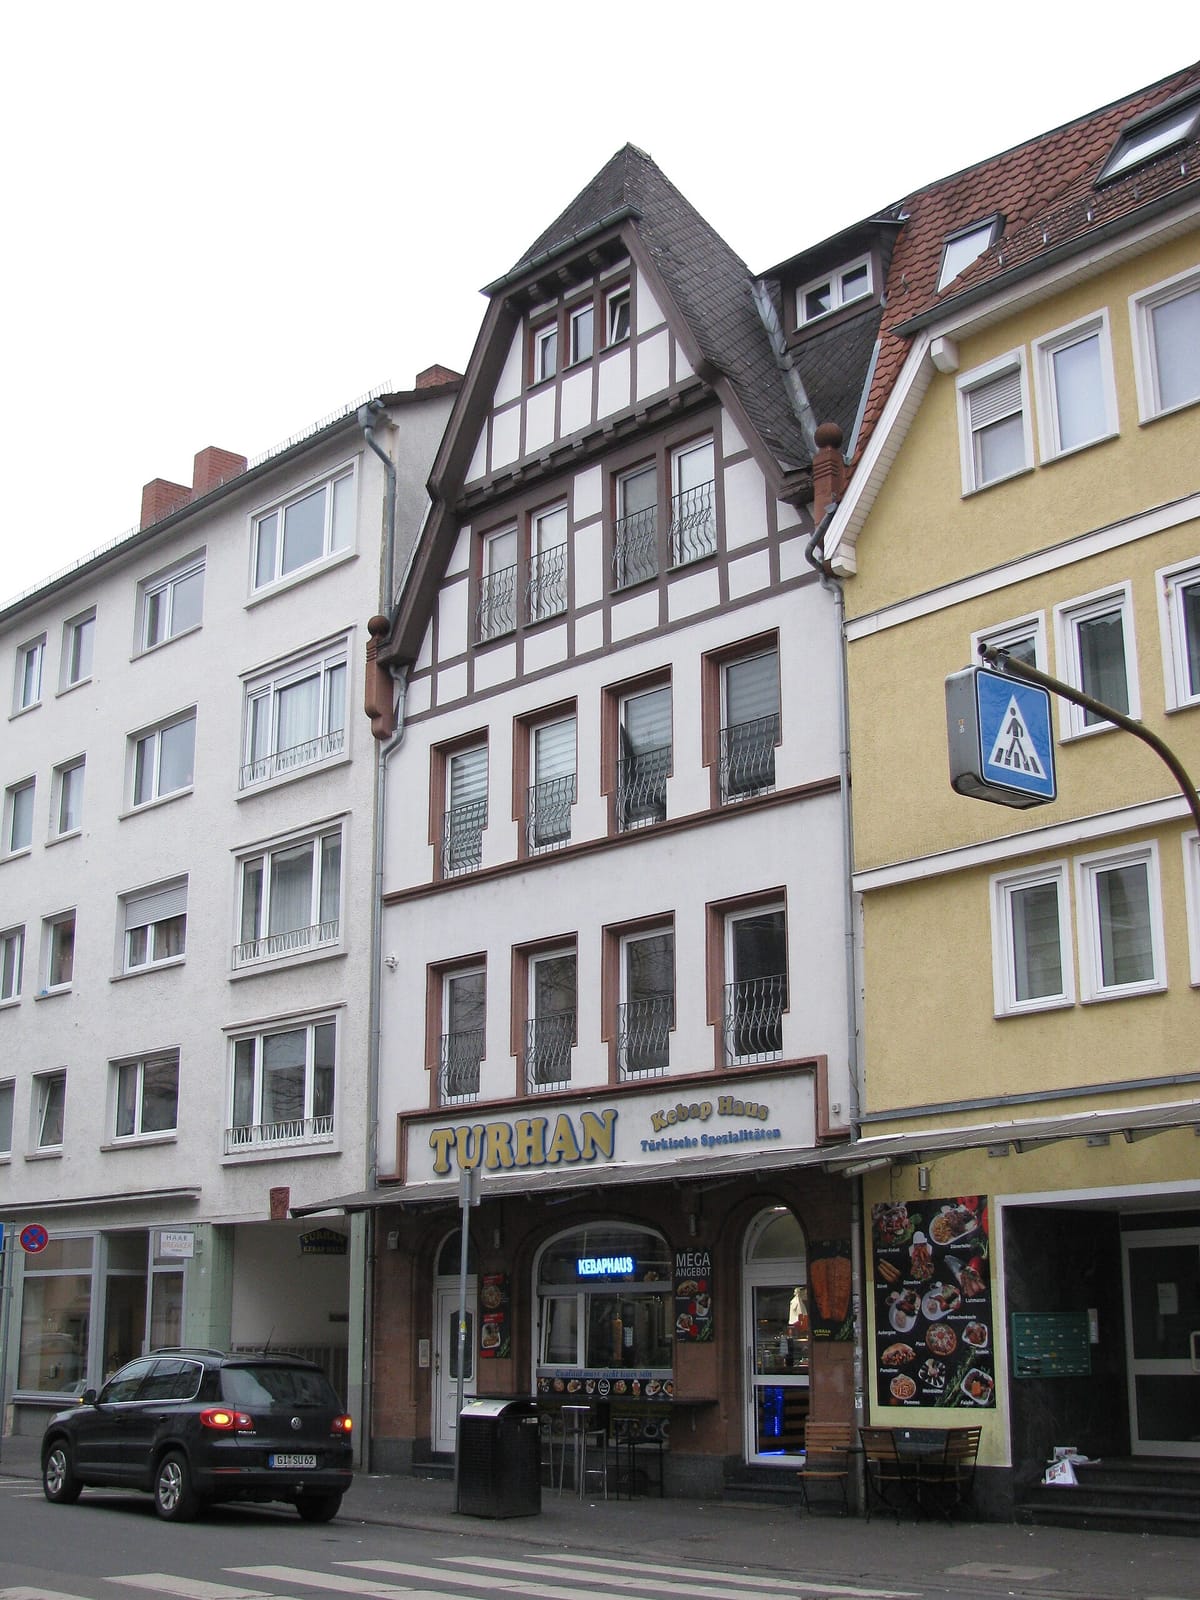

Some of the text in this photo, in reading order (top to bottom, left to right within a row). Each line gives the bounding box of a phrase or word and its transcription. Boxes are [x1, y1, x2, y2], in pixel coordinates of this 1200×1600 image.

[651, 1096, 769, 1132] Kebap Haus
[429, 1109, 619, 1174] TURHAN
[640, 1128, 781, 1152] Türkische Spezialitäten
[578, 1257, 633, 1274] KEBAPHAUS
[676, 1252, 711, 1267] MEGA
[676, 1267, 711, 1277] ANGEBOT
